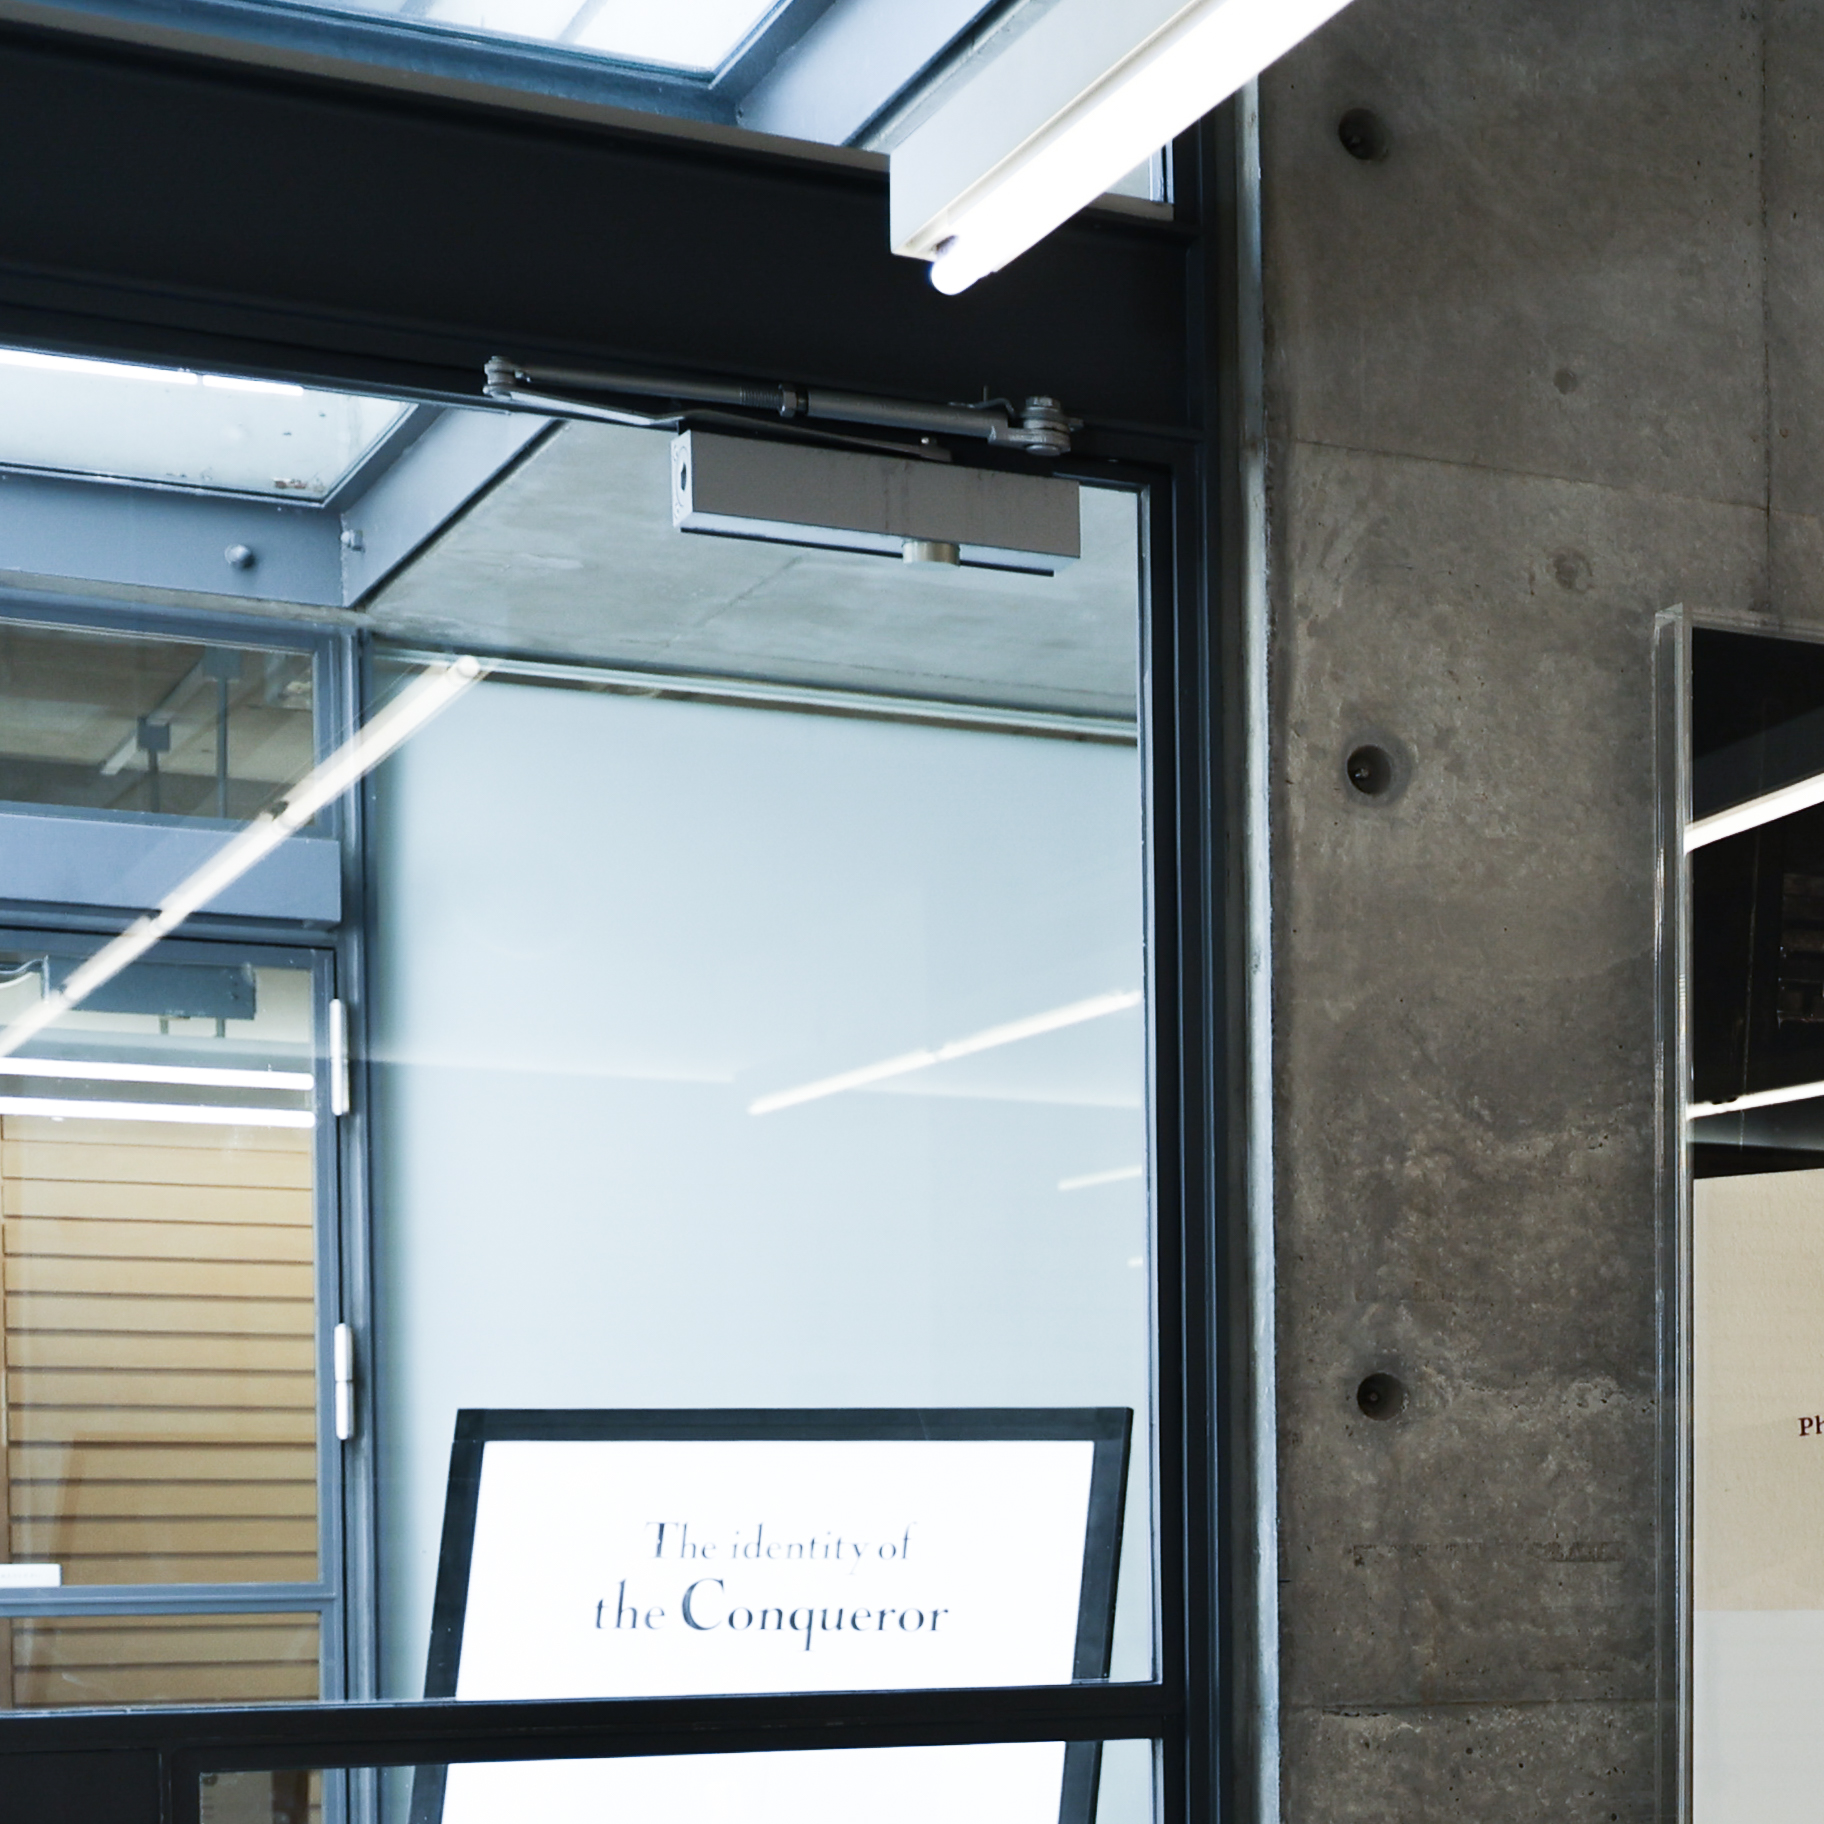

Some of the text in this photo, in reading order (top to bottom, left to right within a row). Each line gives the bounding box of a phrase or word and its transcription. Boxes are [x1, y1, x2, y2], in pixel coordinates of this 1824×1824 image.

[647, 1522, 917, 1574] The identity of
[595, 1578, 949, 1651] the Conqueror
